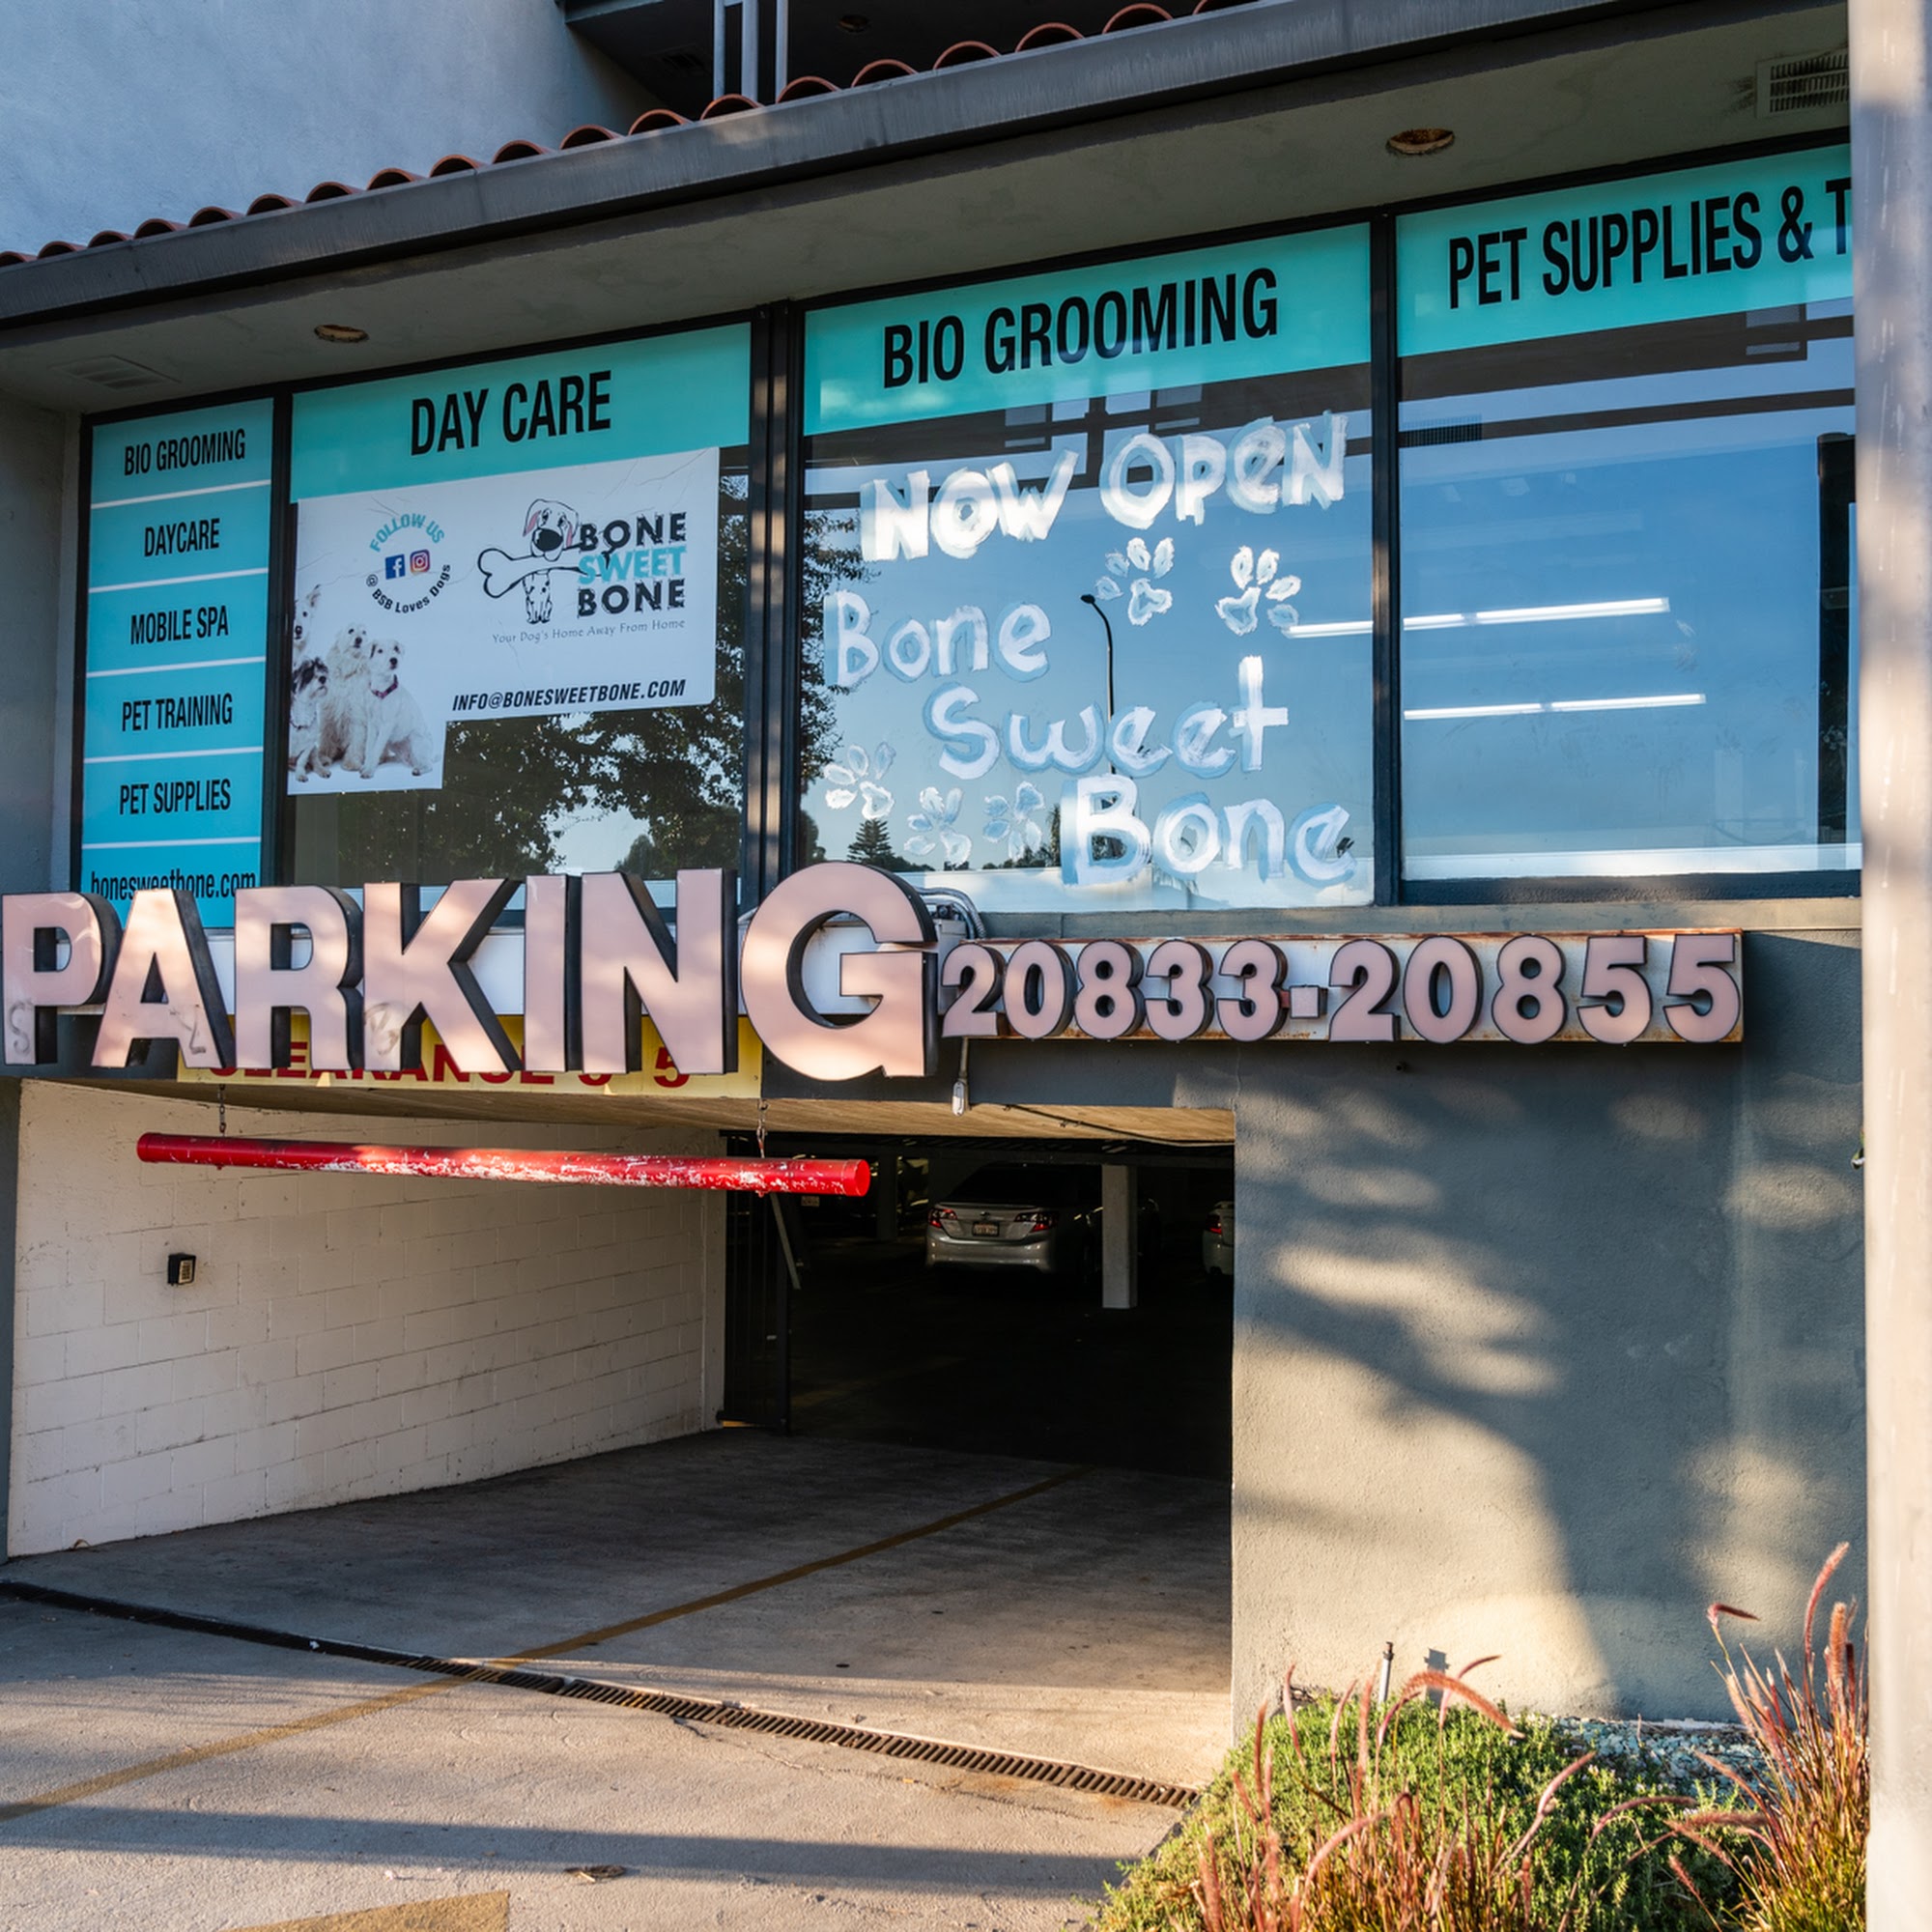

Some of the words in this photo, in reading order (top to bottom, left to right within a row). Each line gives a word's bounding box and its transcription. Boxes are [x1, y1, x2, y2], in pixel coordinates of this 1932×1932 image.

[1449, 227, 1527, 309] PET
[1543, 191, 1762, 296] SUPPLIES
[1777, 185, 1813, 263] &
[883, 315, 964, 387] BIO
[984, 268, 1278, 374] GROOMING
[411, 388, 489, 456] DAY
[502, 370, 611, 443] CARE
[124, 442, 152, 475] BIO
[156, 428, 246, 470] GROOMING
[860, 450, 1079, 561] NOW
[144, 518, 220, 557] DAYCARE
[369, 513, 426, 553] FOLLOW
[426, 520, 445, 544] US
[579, 511, 687, 553] BONE
[372, 588, 393, 611] BSB
[395, 596, 430, 613] Loves
[429, 564, 451, 597] Dogs
[578, 545, 688, 585] SWEET
[577, 578, 685, 618] BONE
[130, 609, 192, 645] MOBILE
[197, 605, 229, 639] SPA
[493, 633, 517, 644] Your
[520, 630, 550, 644] Dog's
[553, 628, 583, 639] Home
[586, 625, 616, 639] Away
[619, 622, 648, 634] From
[652, 619, 686, 631] Home
[823, 588, 1052, 686] Bone
[122, 698, 152, 732] PET
[155, 692, 233, 728] TRAINING
[452, 679, 686, 713] INFO@BONESWEETBONE.COM
[923, 654, 1290, 781] Sweet
[119, 783, 149, 816] PET
[153, 778, 232, 813] SUPPLIES
[1061, 774, 1358, 889] Bone
[0, 861, 939, 1082] PARKING
[940, 933, 1742, 1045] 20833-20855
